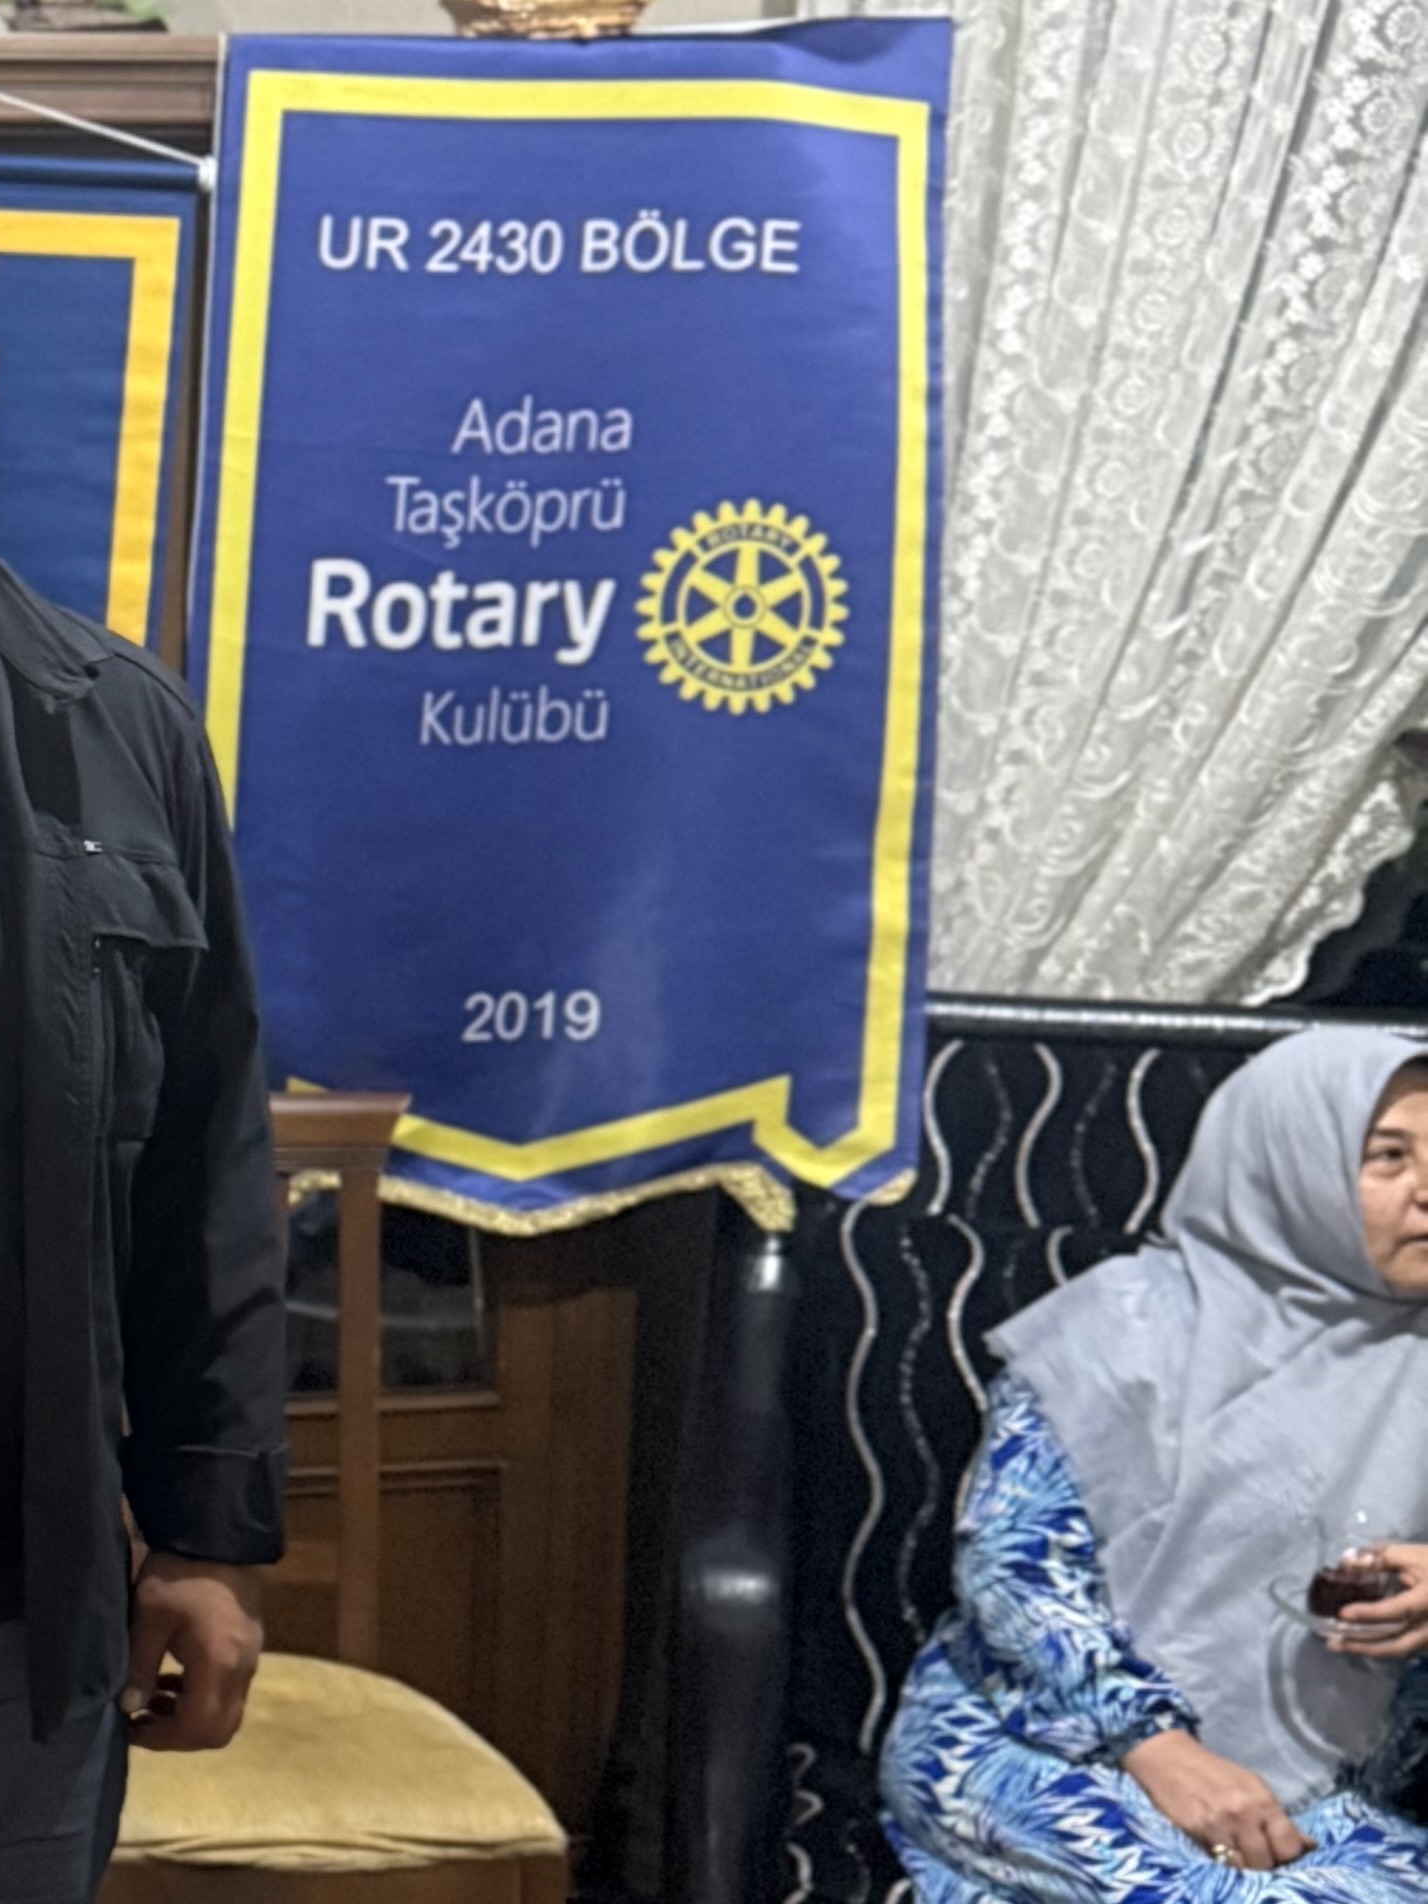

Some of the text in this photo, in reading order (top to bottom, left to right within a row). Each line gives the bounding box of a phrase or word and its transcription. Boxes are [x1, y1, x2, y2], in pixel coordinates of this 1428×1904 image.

[318, 208, 802, 275] UR 2430 BÖLGE
[450, 394, 634, 455] Adana
[385, 474, 627, 550] Taşköprü
[705, 524, 792, 549] ROTARY
[306, 557, 617, 666] Rotary
[419, 684, 610, 746] Kulübü
[462, 988, 602, 1043] 2019
